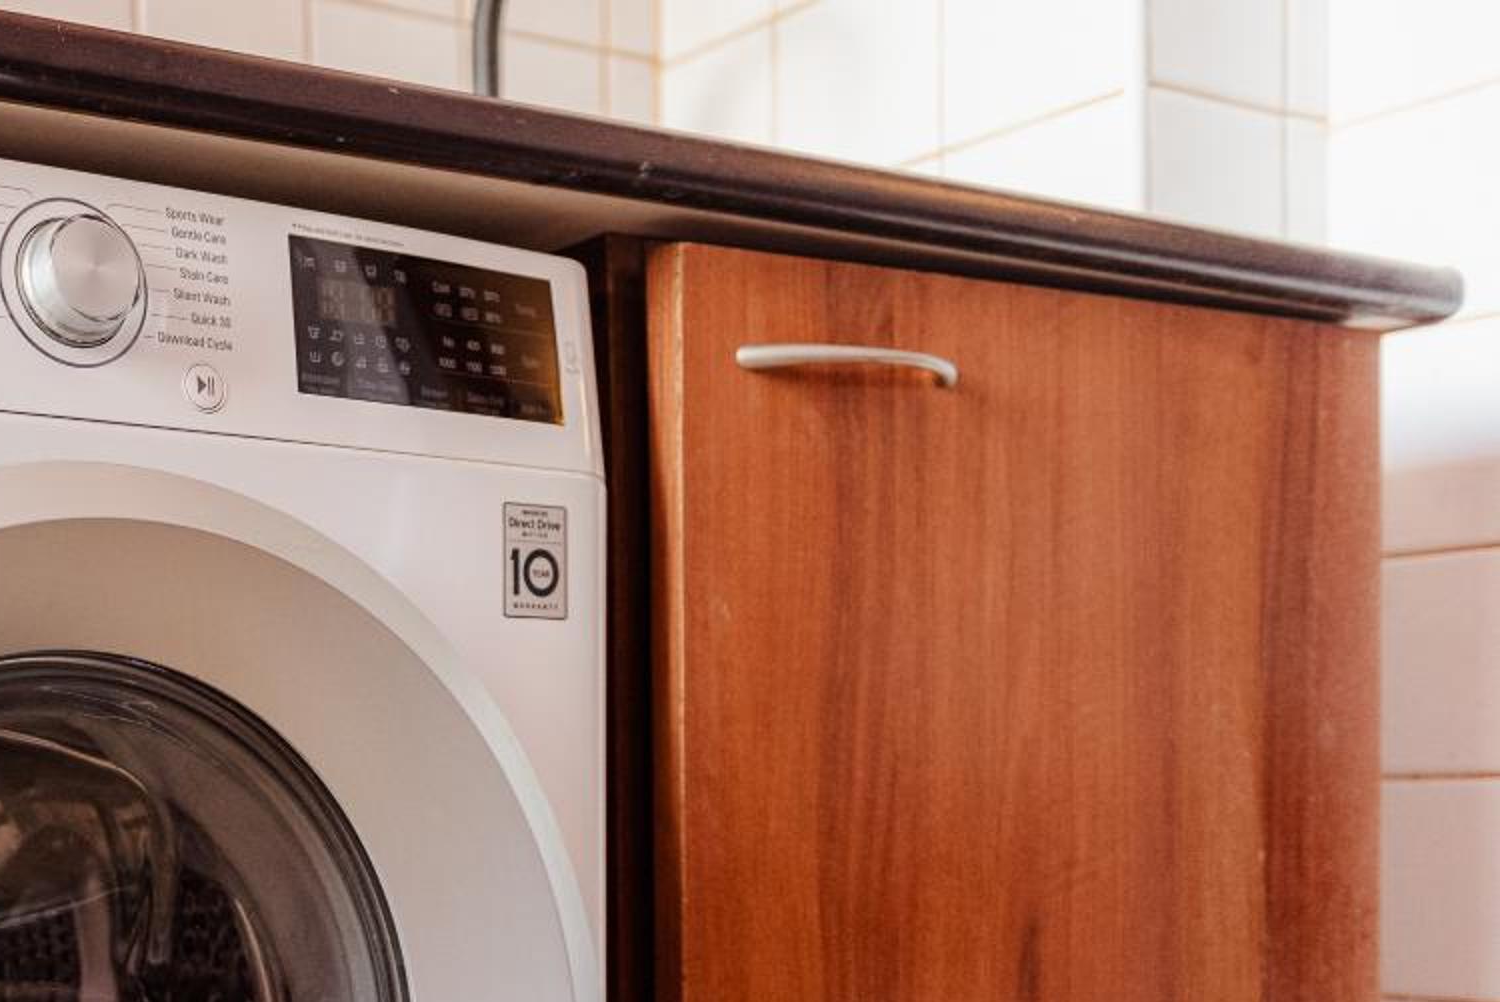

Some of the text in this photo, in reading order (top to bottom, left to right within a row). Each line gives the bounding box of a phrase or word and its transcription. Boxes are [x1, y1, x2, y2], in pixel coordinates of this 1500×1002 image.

[508, 517, 560, 531] Direct Drive
[510, 548, 559, 598] 10
